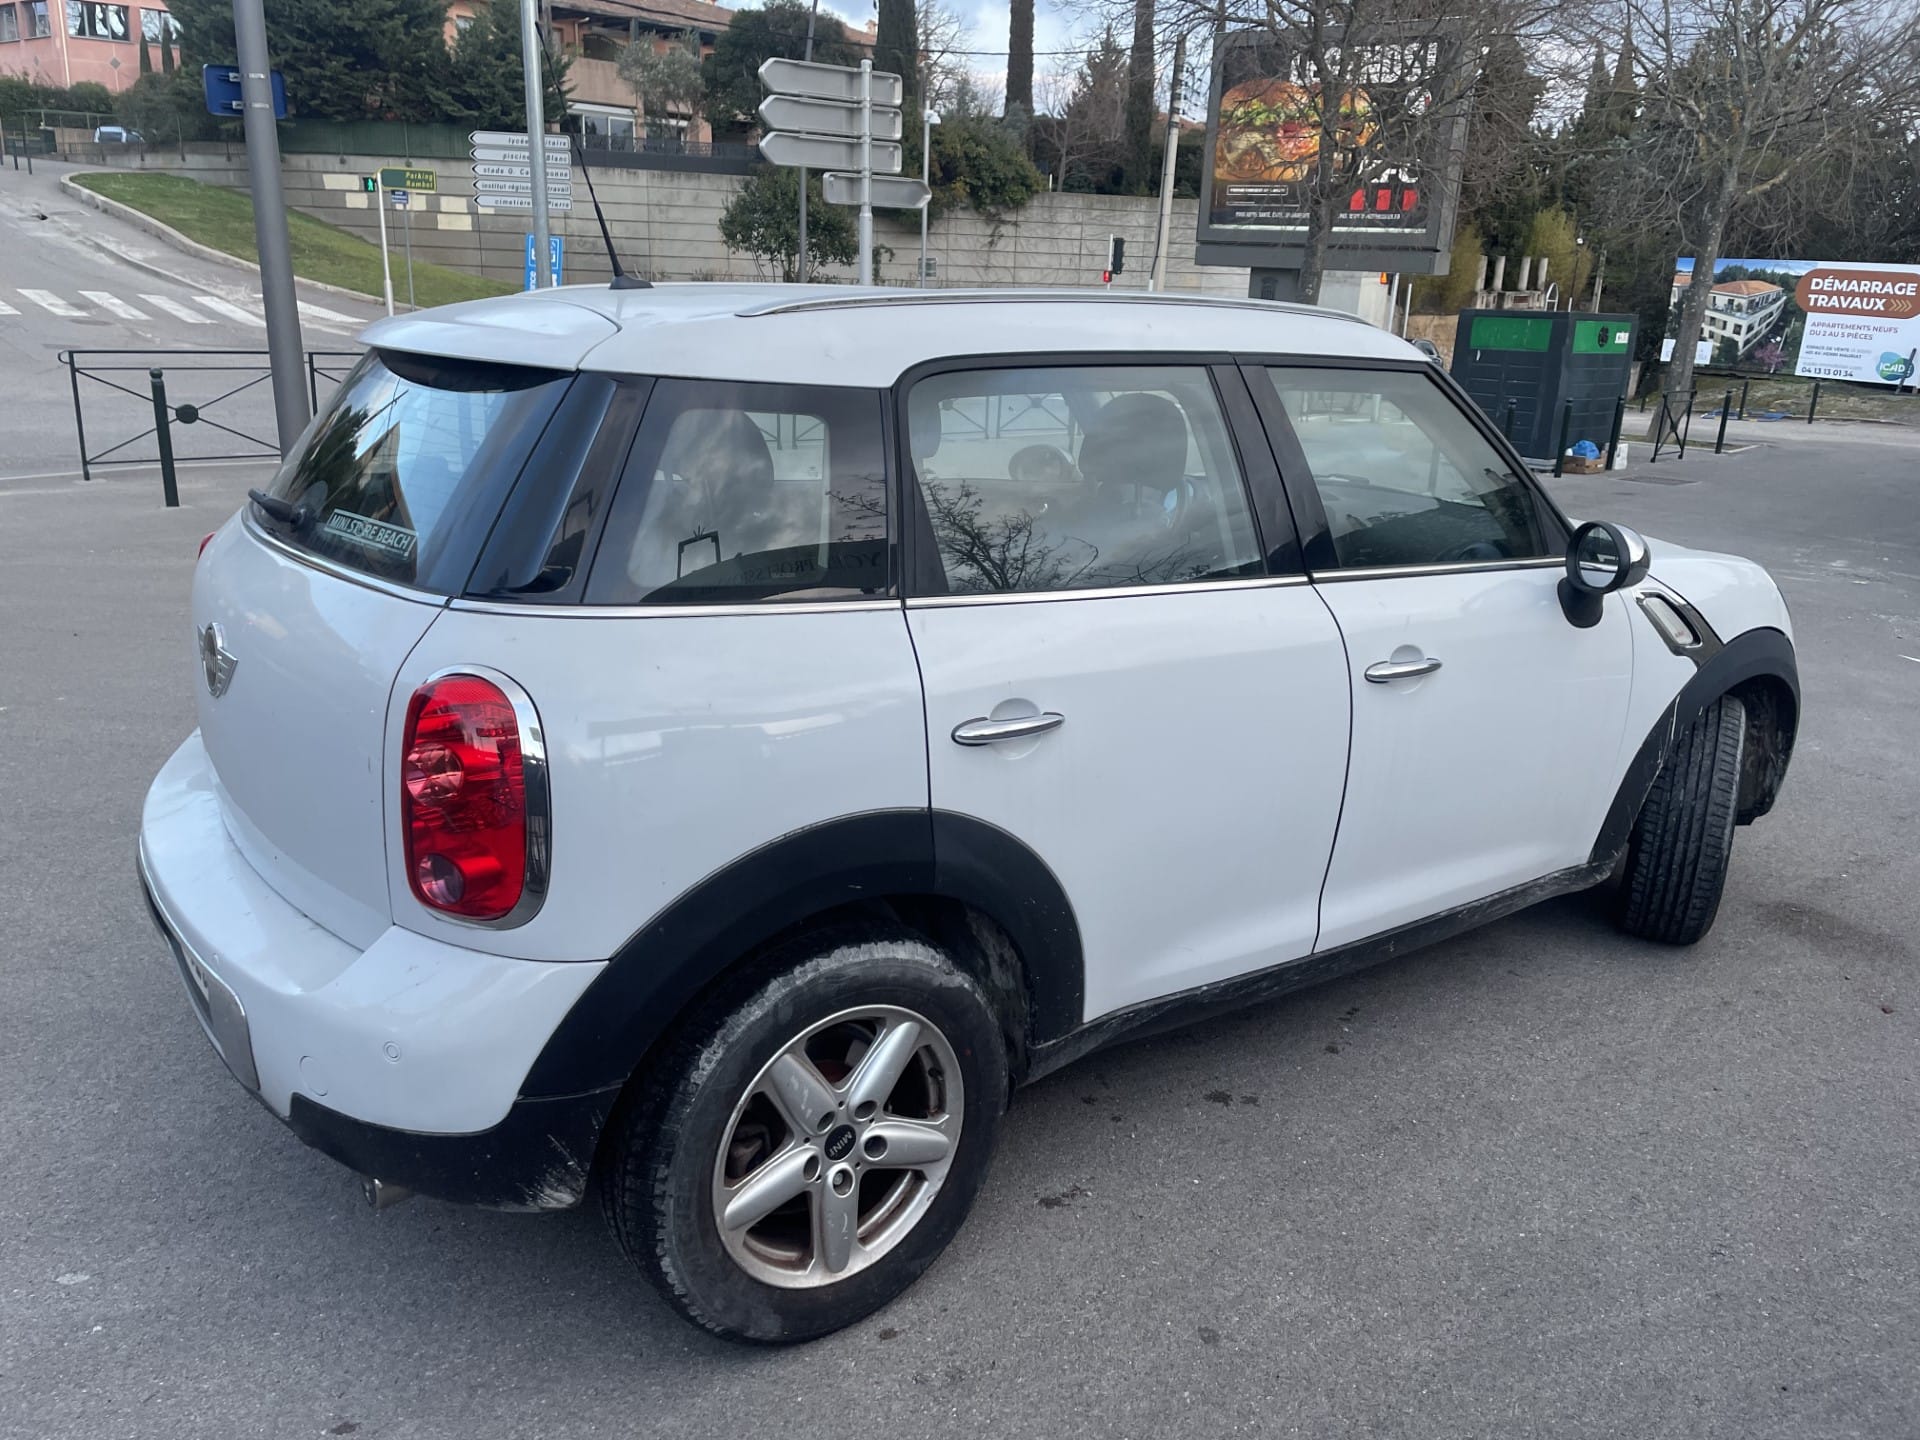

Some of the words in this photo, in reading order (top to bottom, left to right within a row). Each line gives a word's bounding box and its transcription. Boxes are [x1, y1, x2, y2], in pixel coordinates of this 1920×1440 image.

[483, 167, 505, 175] stade
[481, 182, 507, 190] institut
[1811, 276, 1918, 296] DÉMARRAGE
[1808, 294, 1887, 311] TRAVAUX
[1810, 321, 1871, 331] APPARTEMENTS
[1872, 326, 1899, 334] NEUFS
[1828, 330, 1839, 338] AU
[1846, 331, 1873, 341] PIÈCES
[1833, 369, 1842, 377] 01
[1879, 361, 1913, 374] ICAD
[330, 514, 350, 530] MINI
[376, 528, 410, 550] BEACH
[829, 1131, 853, 1157] MINI
